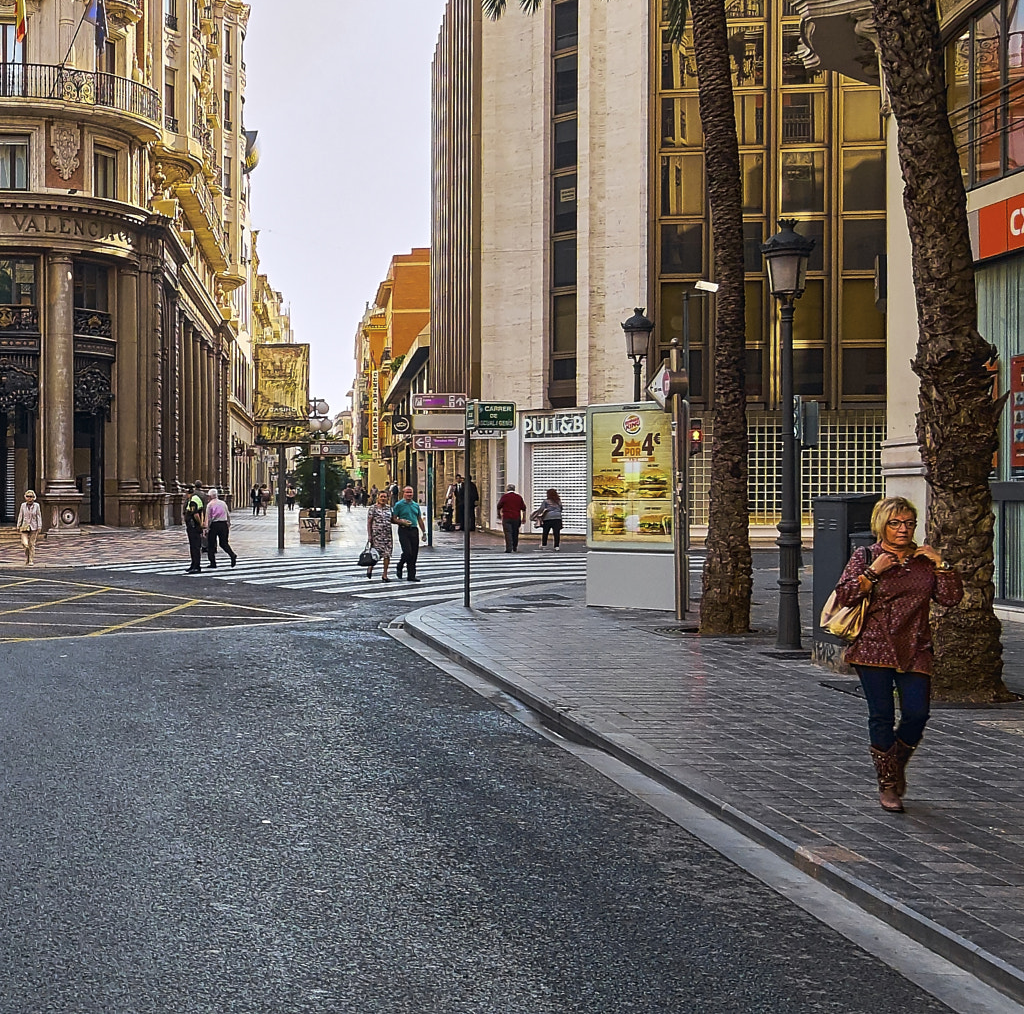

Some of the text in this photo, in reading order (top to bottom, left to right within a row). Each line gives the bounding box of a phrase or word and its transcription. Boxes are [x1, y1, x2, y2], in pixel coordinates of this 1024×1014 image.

[11, 214, 116, 242] VALENCIA
[525, 417, 587, 435] PULL&B
[611, 432, 661, 457] 2 POR 4€
